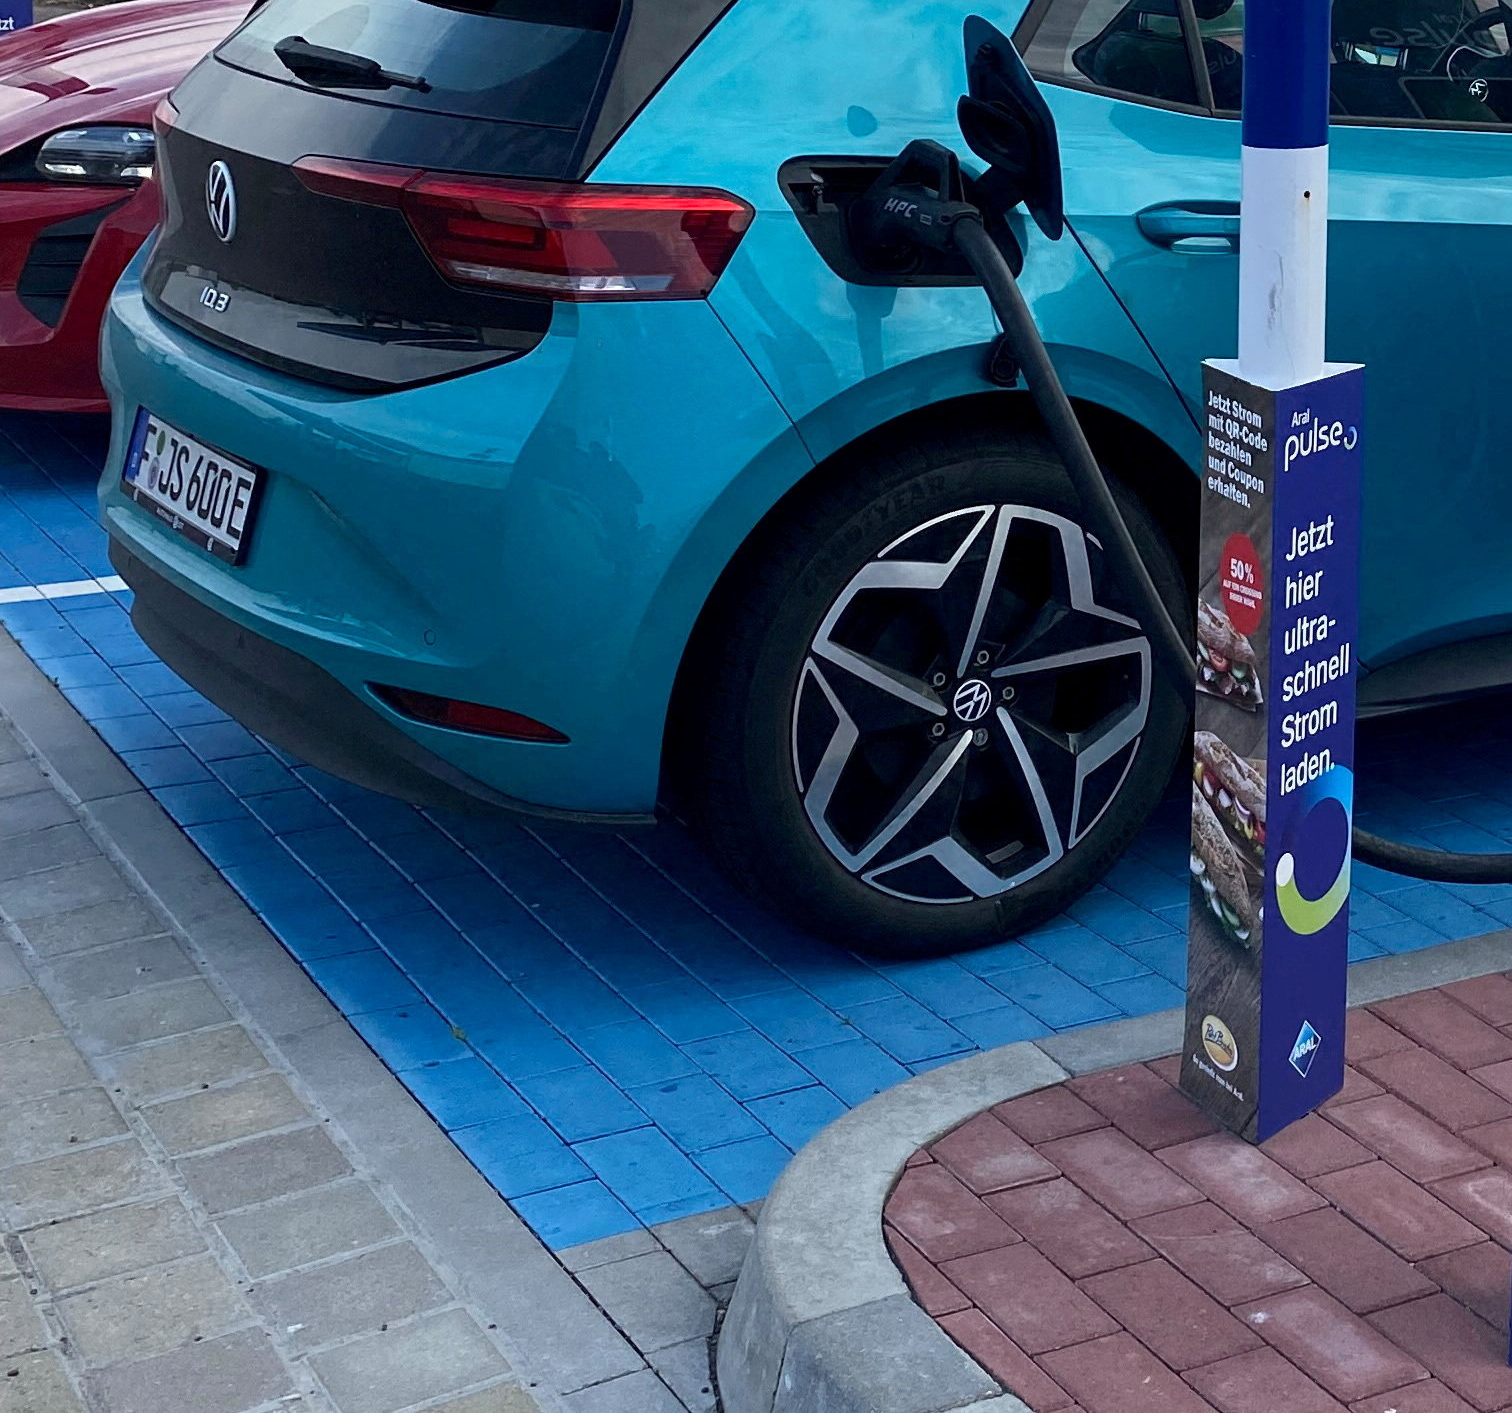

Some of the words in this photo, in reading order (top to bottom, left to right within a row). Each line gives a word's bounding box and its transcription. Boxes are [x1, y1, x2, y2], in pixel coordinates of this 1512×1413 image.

[883, 196, 918, 218] HPC
[1208, 390, 1231, 416] Jetzt
[1231, 399, 1262, 429] Strom
[1291, 408, 1310, 428] Aral
[1208, 413, 1225, 431] mit
[1225, 419, 1268, 452] QR-Code
[1208, 431, 1252, 467] bezahlen
[1284, 417, 1343, 472] pulse
[158, 437, 190, 501] JS
[1207, 454, 1226, 475] und
[1227, 461, 1264, 494] Coupon
[1207, 475, 1251, 509] erhalten.
[1285, 514, 1335, 562] Jetzt
[1284, 570, 1323, 610] hier
[1284, 614, 1336, 655] ultra-
[1282, 642, 1350, 702] schnell
[1280, 700, 1338, 748] Strom
[1280, 748, 1336, 796] laden.
[1293, 1038, 1318, 1062] ARAL
